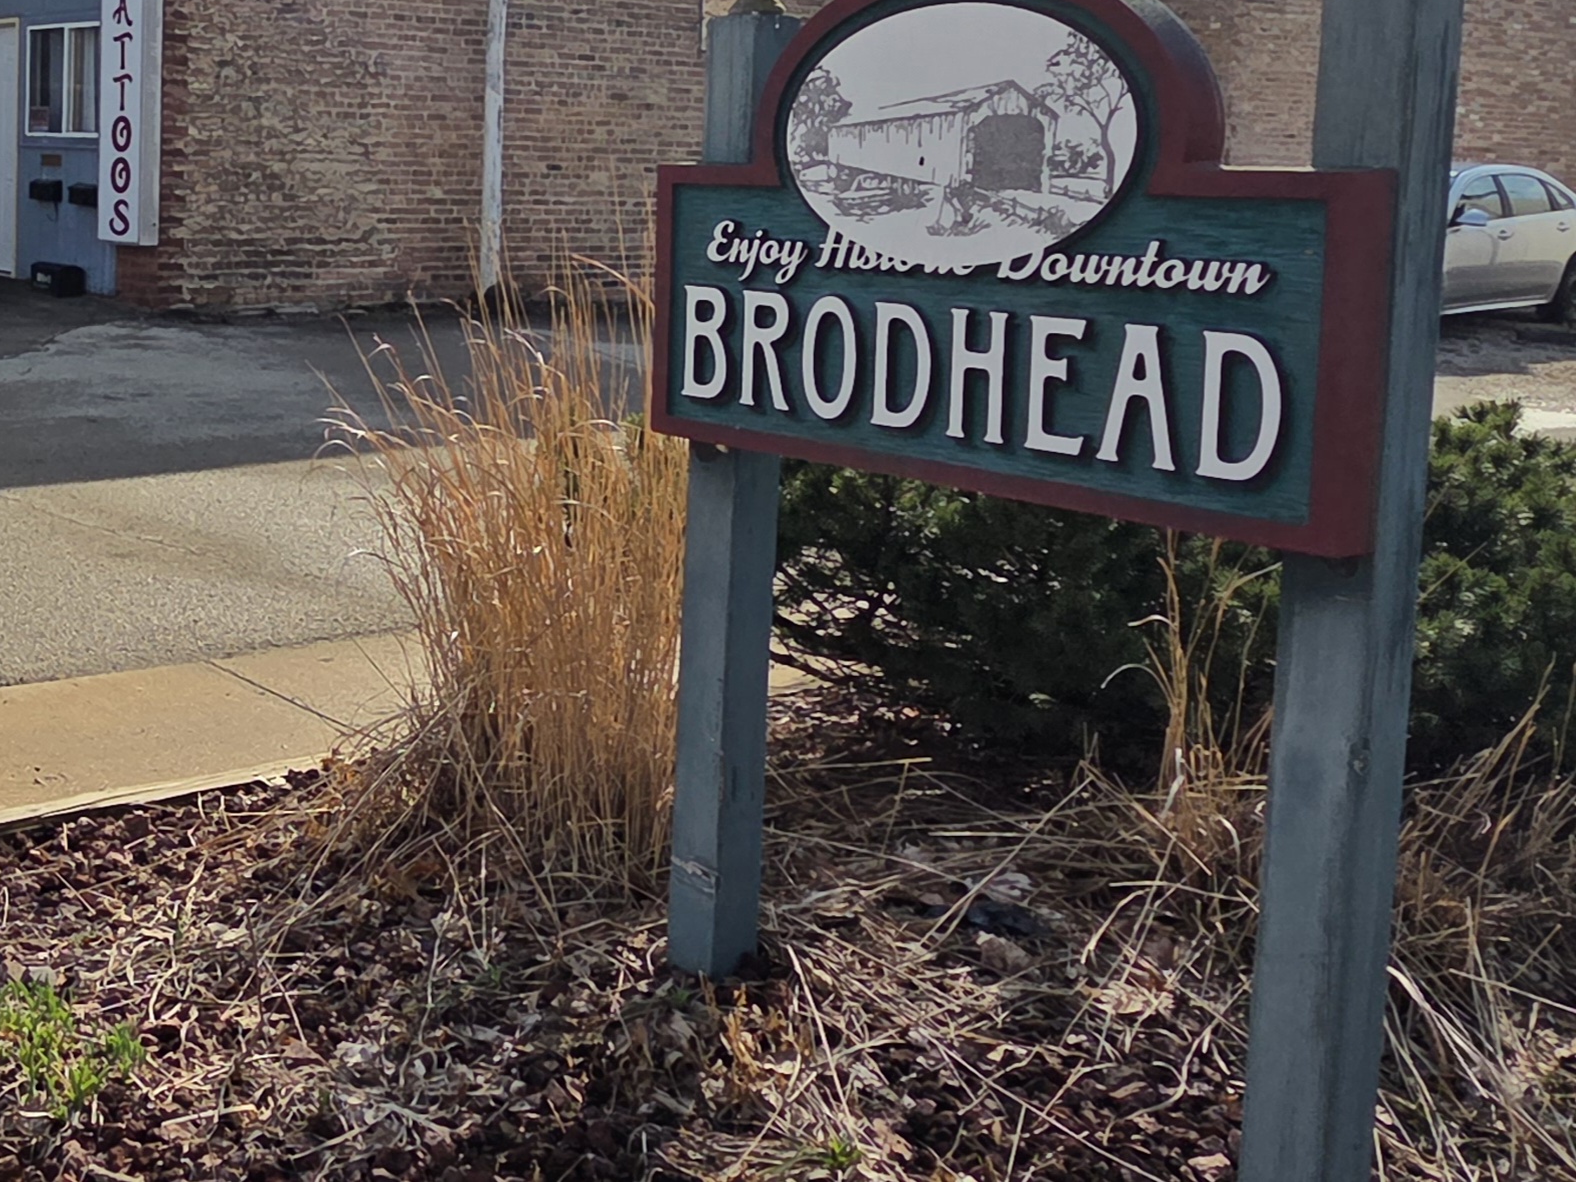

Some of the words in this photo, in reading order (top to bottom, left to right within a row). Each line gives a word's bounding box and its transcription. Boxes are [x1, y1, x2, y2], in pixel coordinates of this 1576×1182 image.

[707, 220, 808, 284] Enjoy
[997, 240, 1271, 295] Downtown
[681, 285, 1282, 482] BRODHEAD
